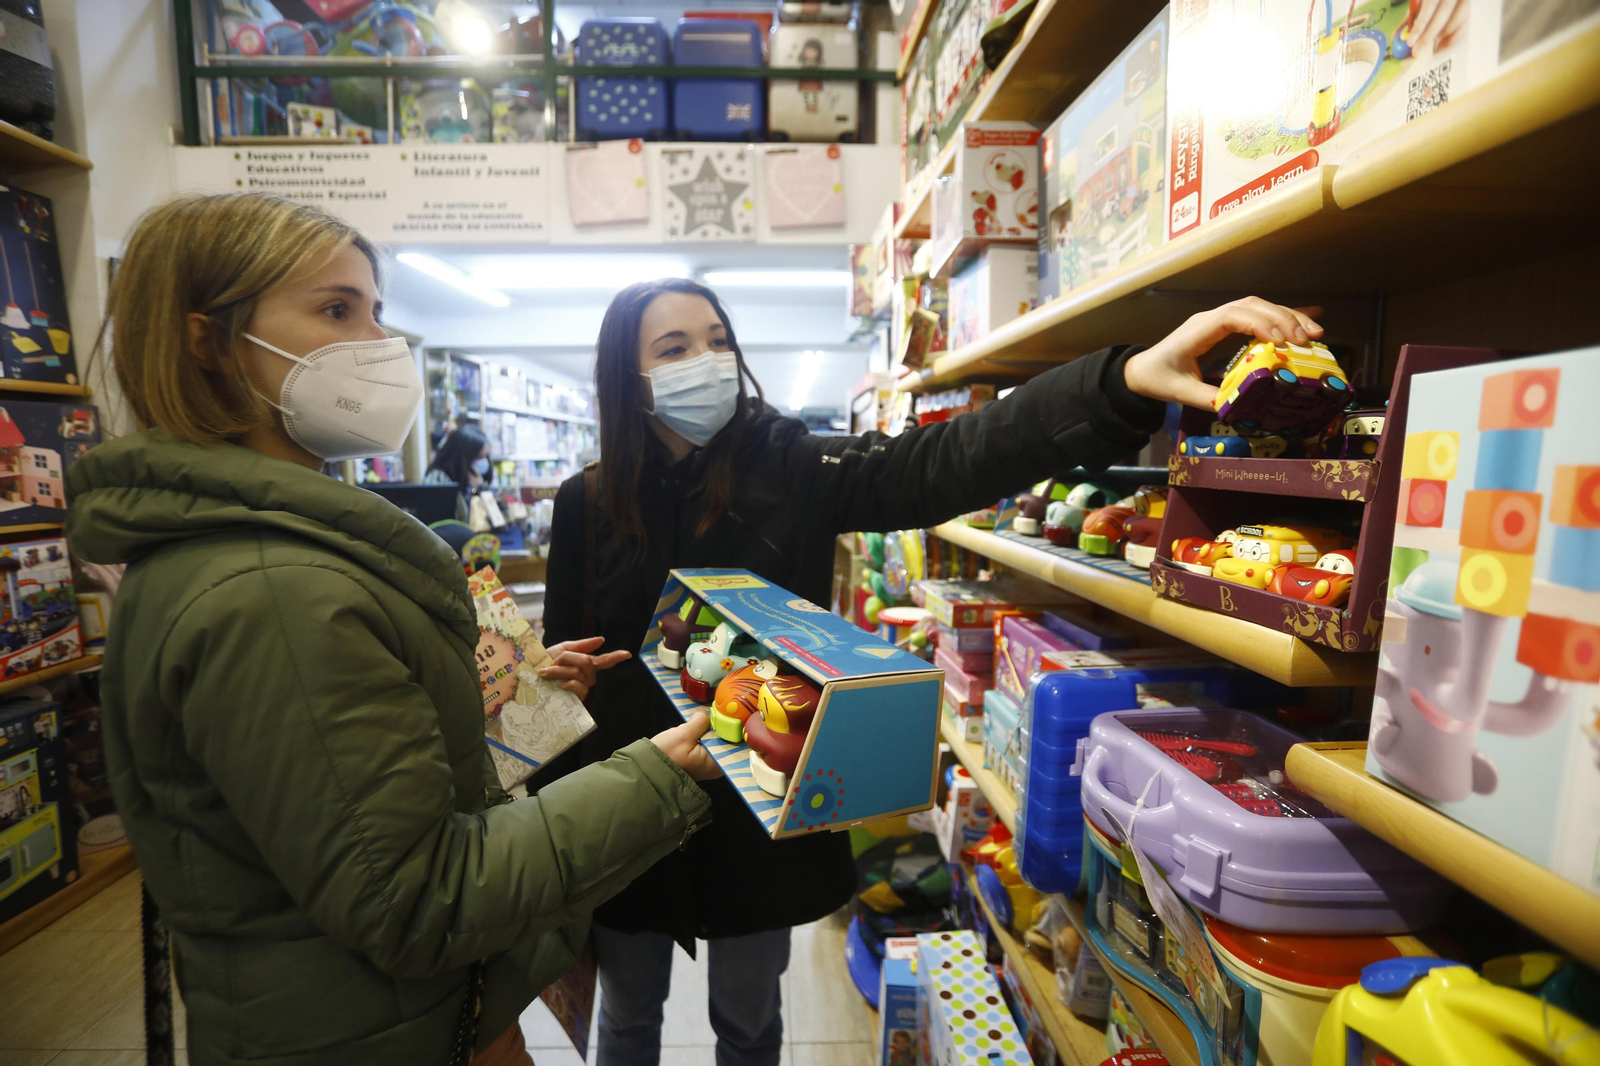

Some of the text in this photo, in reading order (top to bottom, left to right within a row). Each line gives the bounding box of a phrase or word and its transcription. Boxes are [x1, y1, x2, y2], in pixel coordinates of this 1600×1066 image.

[246, 150, 293, 162] Juegos
[309, 150, 370, 162] Juguetes
[413, 151, 488, 162] Literatura
[246, 164, 324, 174] Educativos
[413, 165, 541, 179] Infantil y Juvenil
[249, 177, 366, 187] Psicomotricidad
[328, 189, 387, 199] Especial
[1218, 199, 1240, 215] Love
[1270, 164, 1307, 187] Learn.
[335, 396, 362, 414] KN95
[1255, 442, 1281, 451] POLICE
[1215, 469, 1233, 479] Mini
[1240, 526, 1262, 536] SCHOOL
